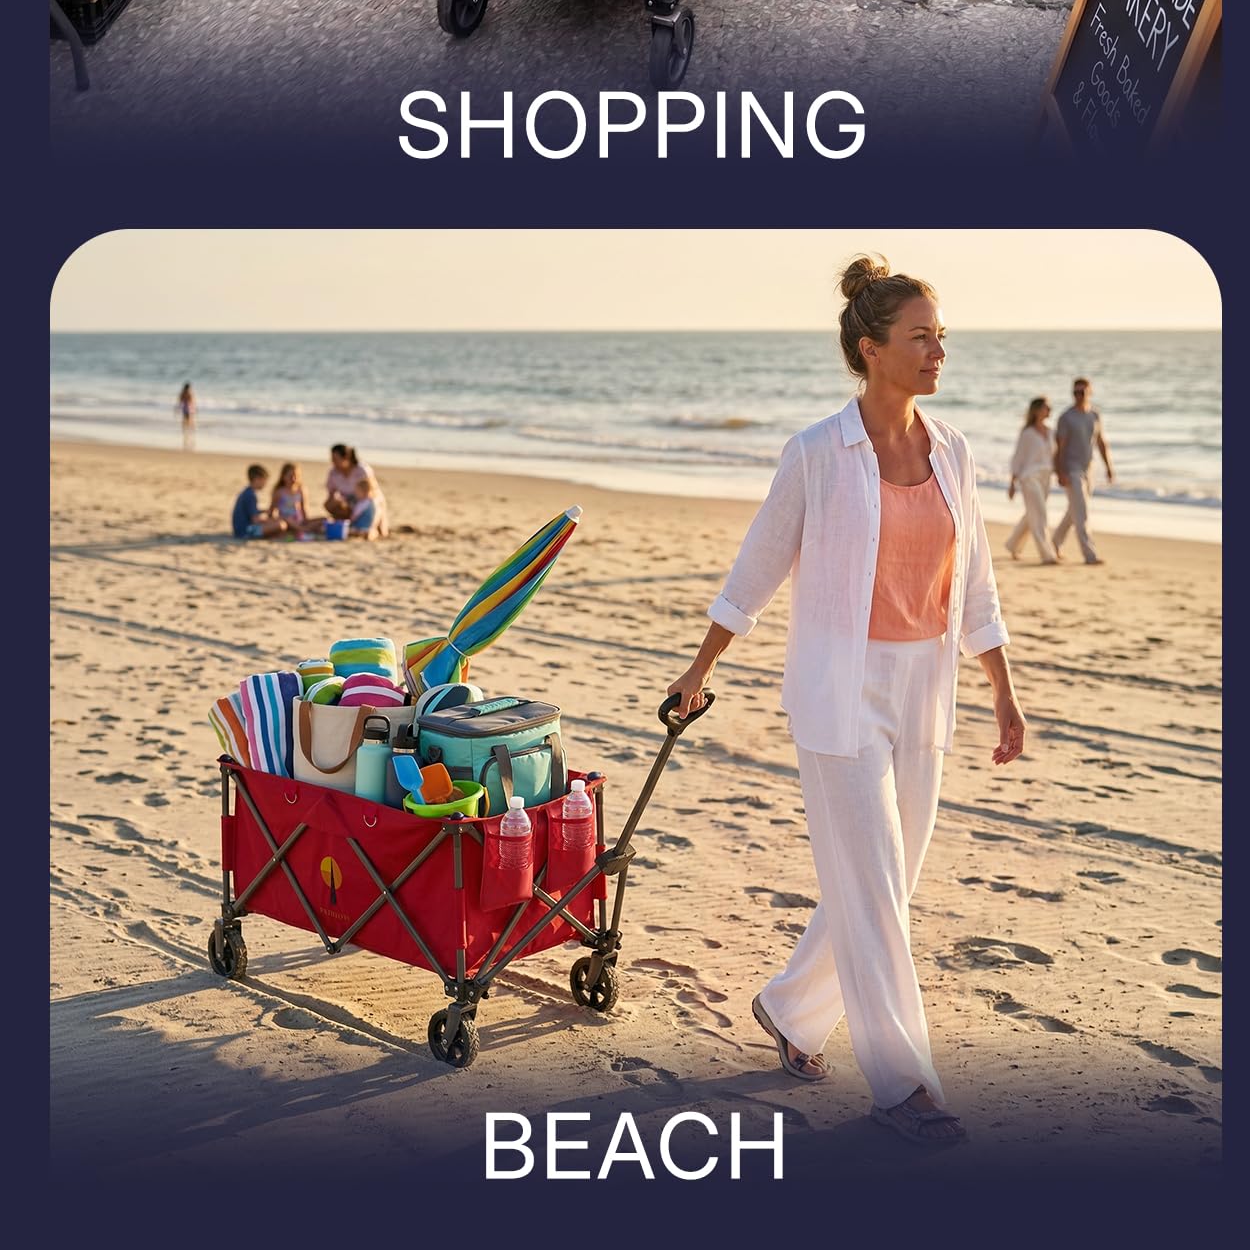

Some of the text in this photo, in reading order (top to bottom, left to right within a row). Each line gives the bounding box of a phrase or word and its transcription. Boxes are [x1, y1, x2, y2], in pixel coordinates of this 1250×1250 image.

[1090, 2, 1152, 127] Fresh Baked
[1091, 60, 1121, 128] Goods
